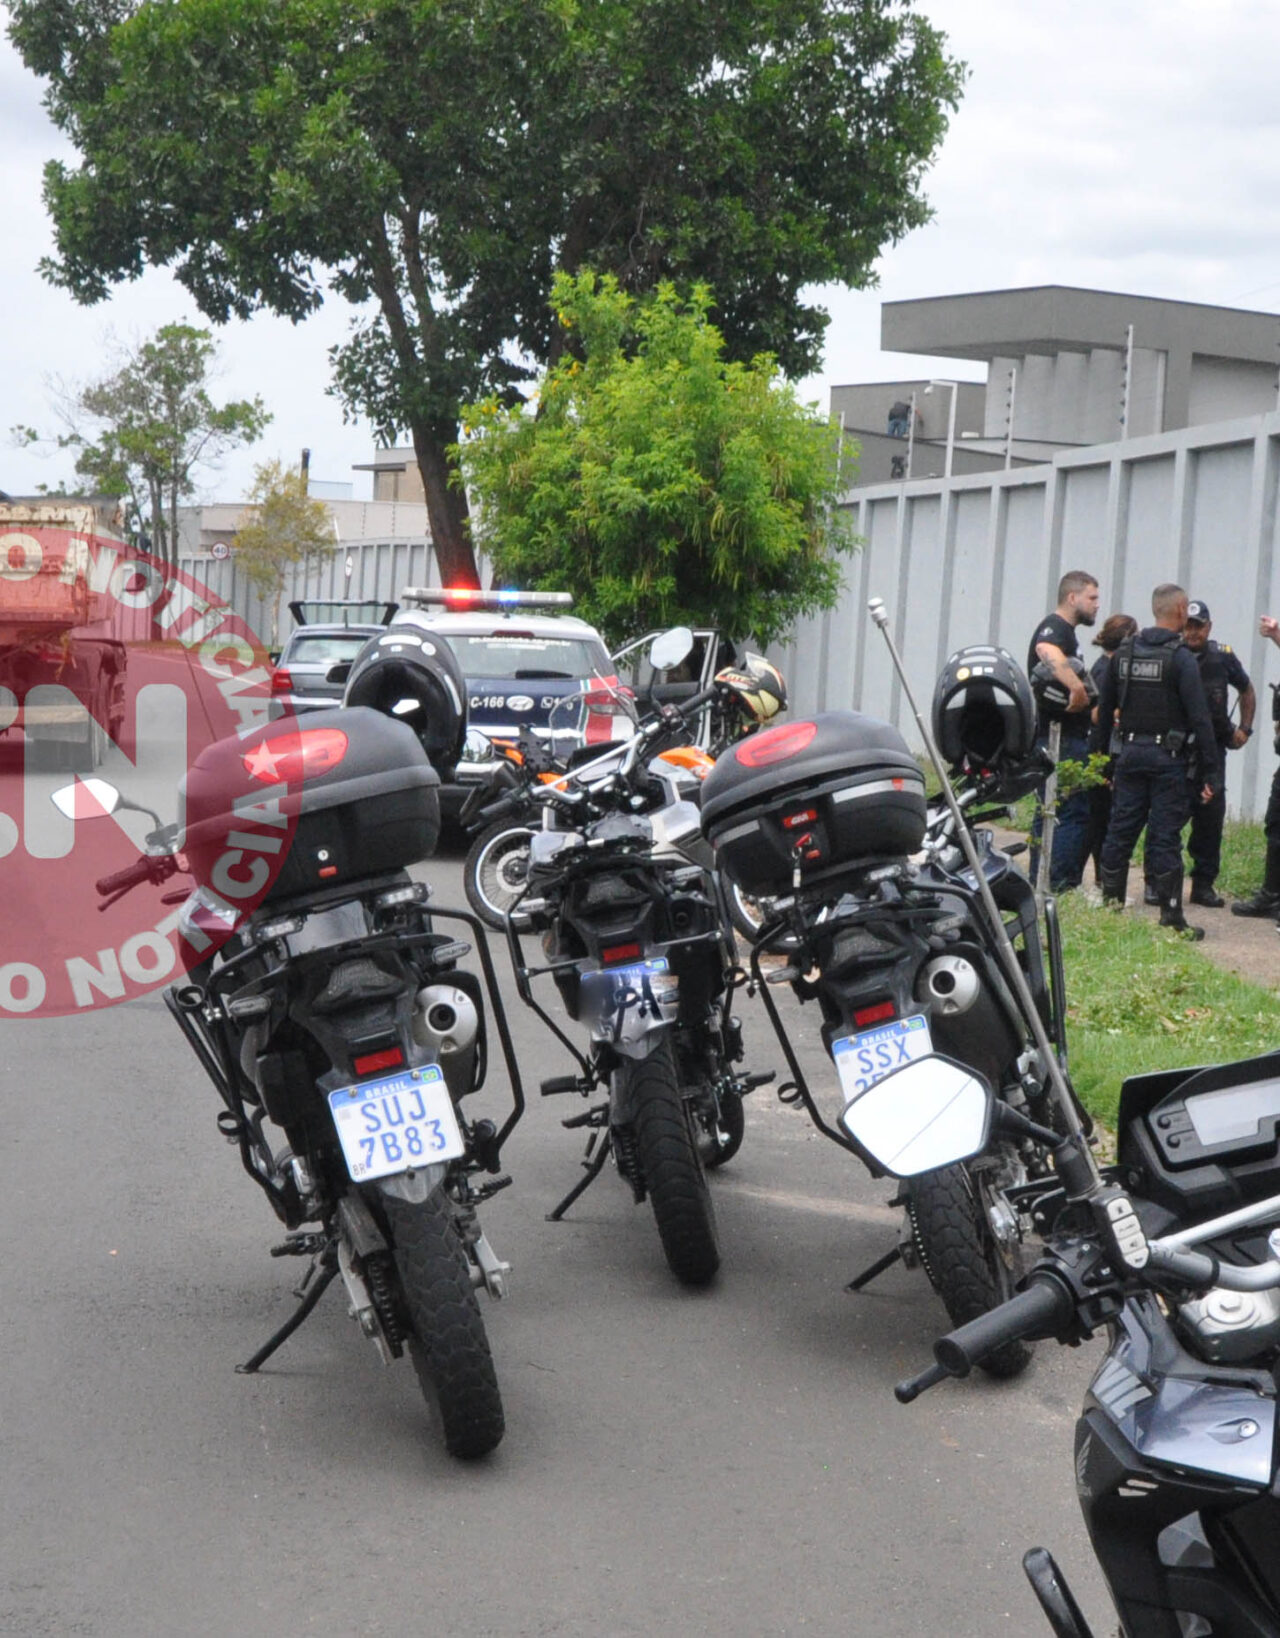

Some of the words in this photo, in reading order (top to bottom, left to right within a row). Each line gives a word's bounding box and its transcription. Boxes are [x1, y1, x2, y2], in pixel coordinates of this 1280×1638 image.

[857, 1036, 911, 1074] SSX
[364, 1081, 408, 1099] BRASIL
[361, 1089, 426, 1133] SUJ
[359, 1119, 446, 1169] 7B83
[352, 1164, 366, 1176] BR
